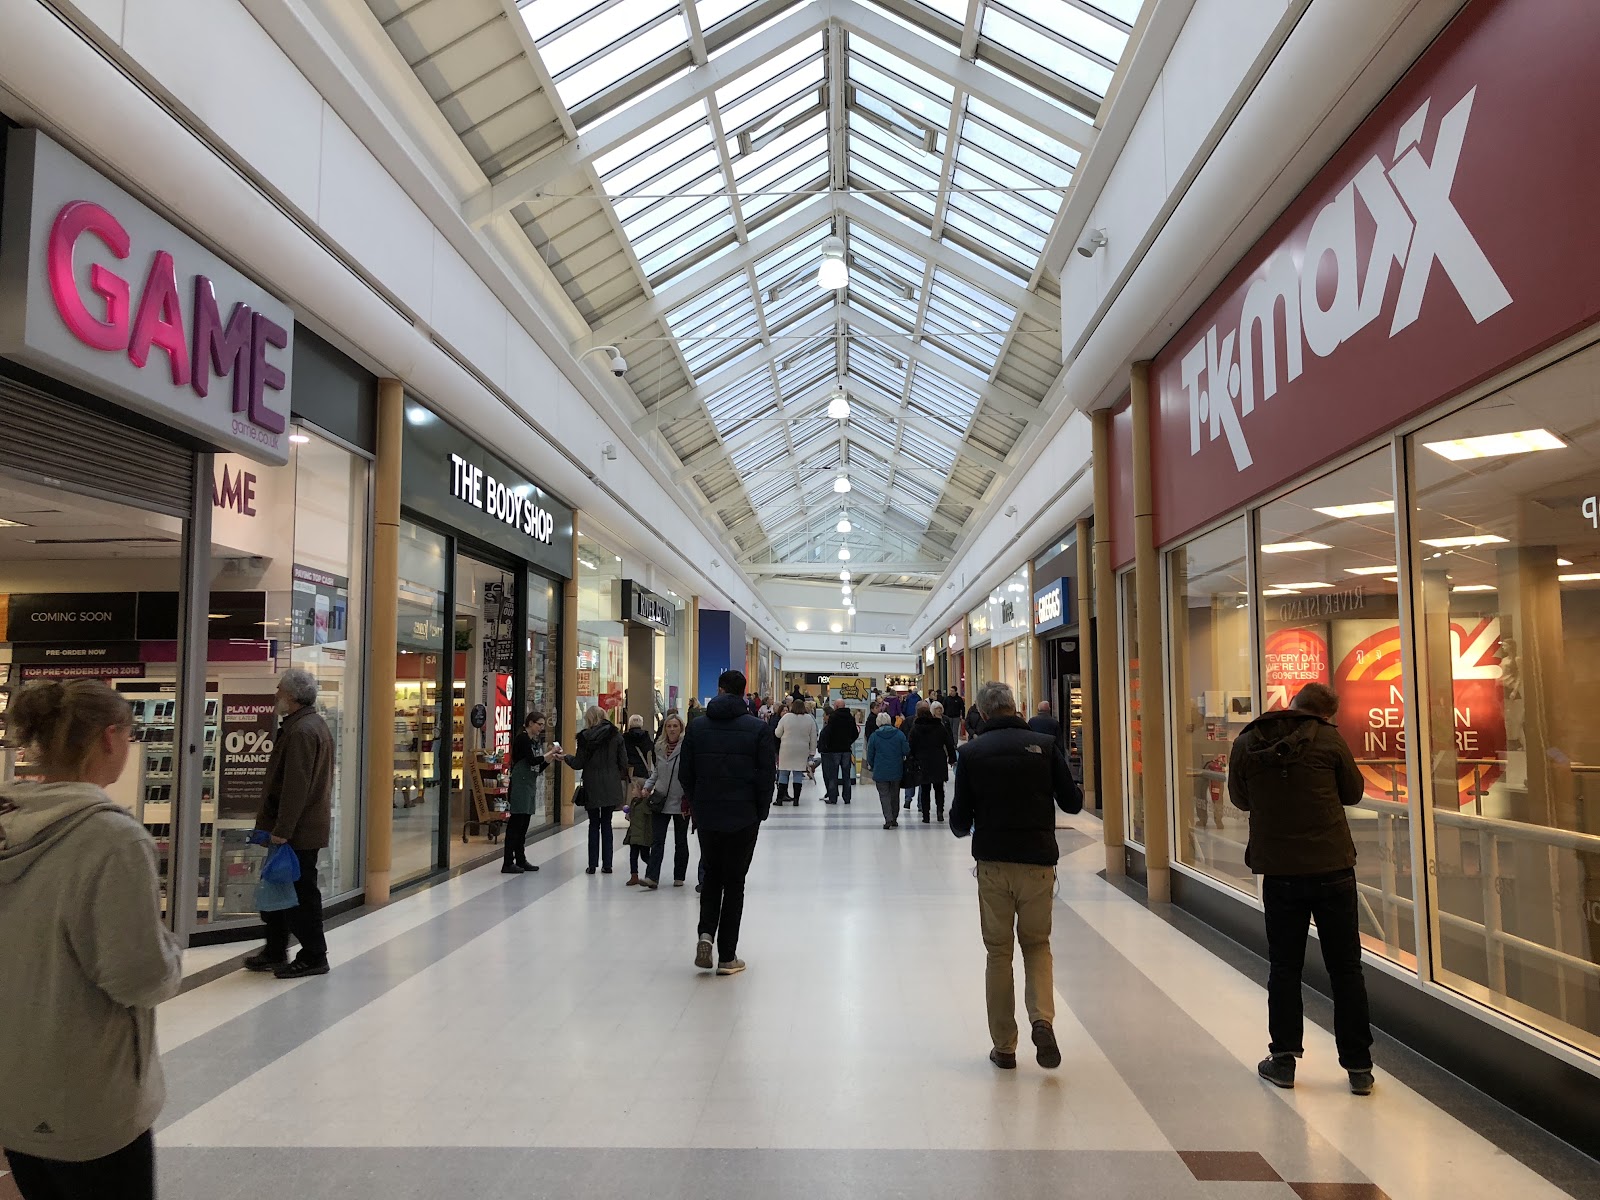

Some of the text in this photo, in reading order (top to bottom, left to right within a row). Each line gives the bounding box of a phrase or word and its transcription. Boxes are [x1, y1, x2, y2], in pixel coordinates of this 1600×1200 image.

[48, 200, 288, 435] GAME
[231, 418, 279, 450] game.co.uk
[449, 453, 554, 544] THE BODY SHOP
[1038, 591, 1060, 624] GREGGS
[31, 611, 112, 622] COMING SOON
[1269, 653, 1320, 662] EVERY DAY
[840, 660, 859, 670] next
[1265, 662, 1325, 671] WE'RE UP TO
[24, 668, 42, 676] TOP
[120, 667, 140, 675] 2018
[1294, 671, 1319, 680] LESS
[817, 675, 831, 684] nex
[226, 705, 275, 713] PLAY NOW
[495, 705, 512, 731] SALE
[225, 731, 274, 753] 0%
[1364, 731, 1387, 752] IN
